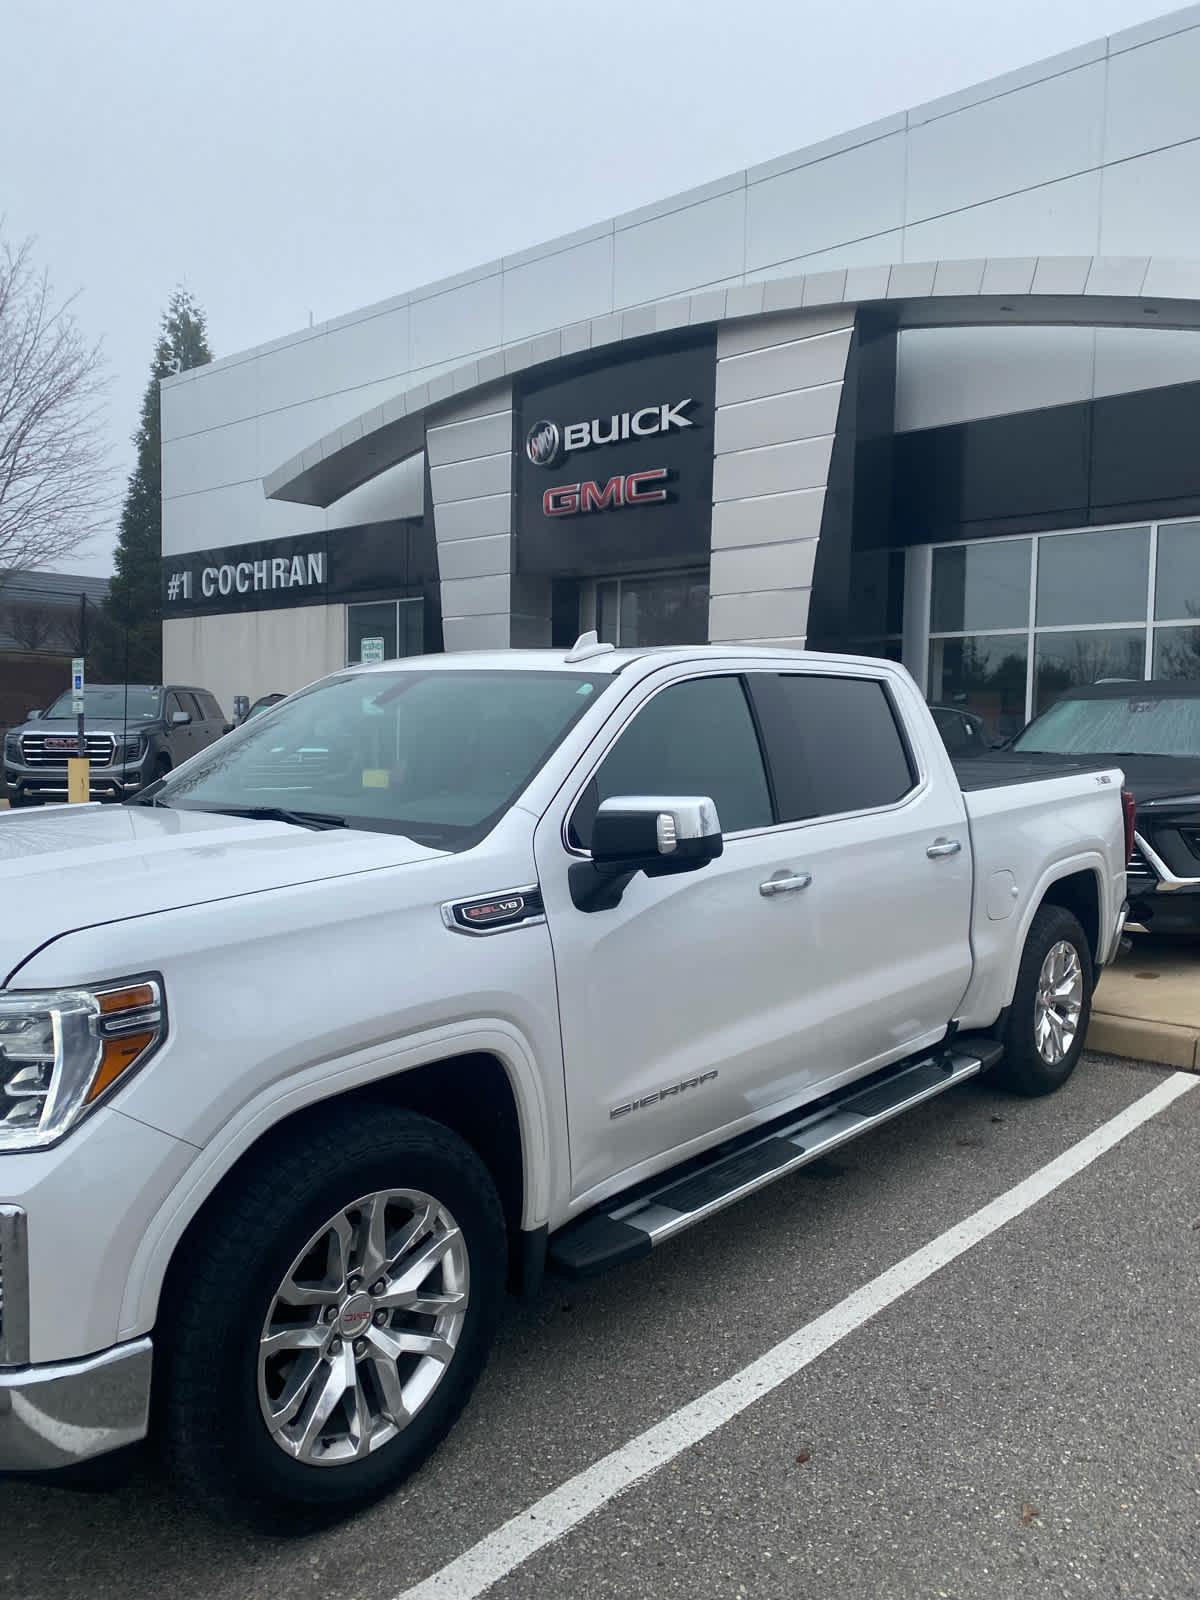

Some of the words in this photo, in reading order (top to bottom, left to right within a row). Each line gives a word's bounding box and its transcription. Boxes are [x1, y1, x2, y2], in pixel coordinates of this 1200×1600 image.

[564, 398, 693, 451] BUICK
[543, 468, 668, 517] GMC
[167, 571, 193, 600] #1
[201, 552, 328, 597] COCHRAN
[609, 1069, 719, 1120] SIERRA
